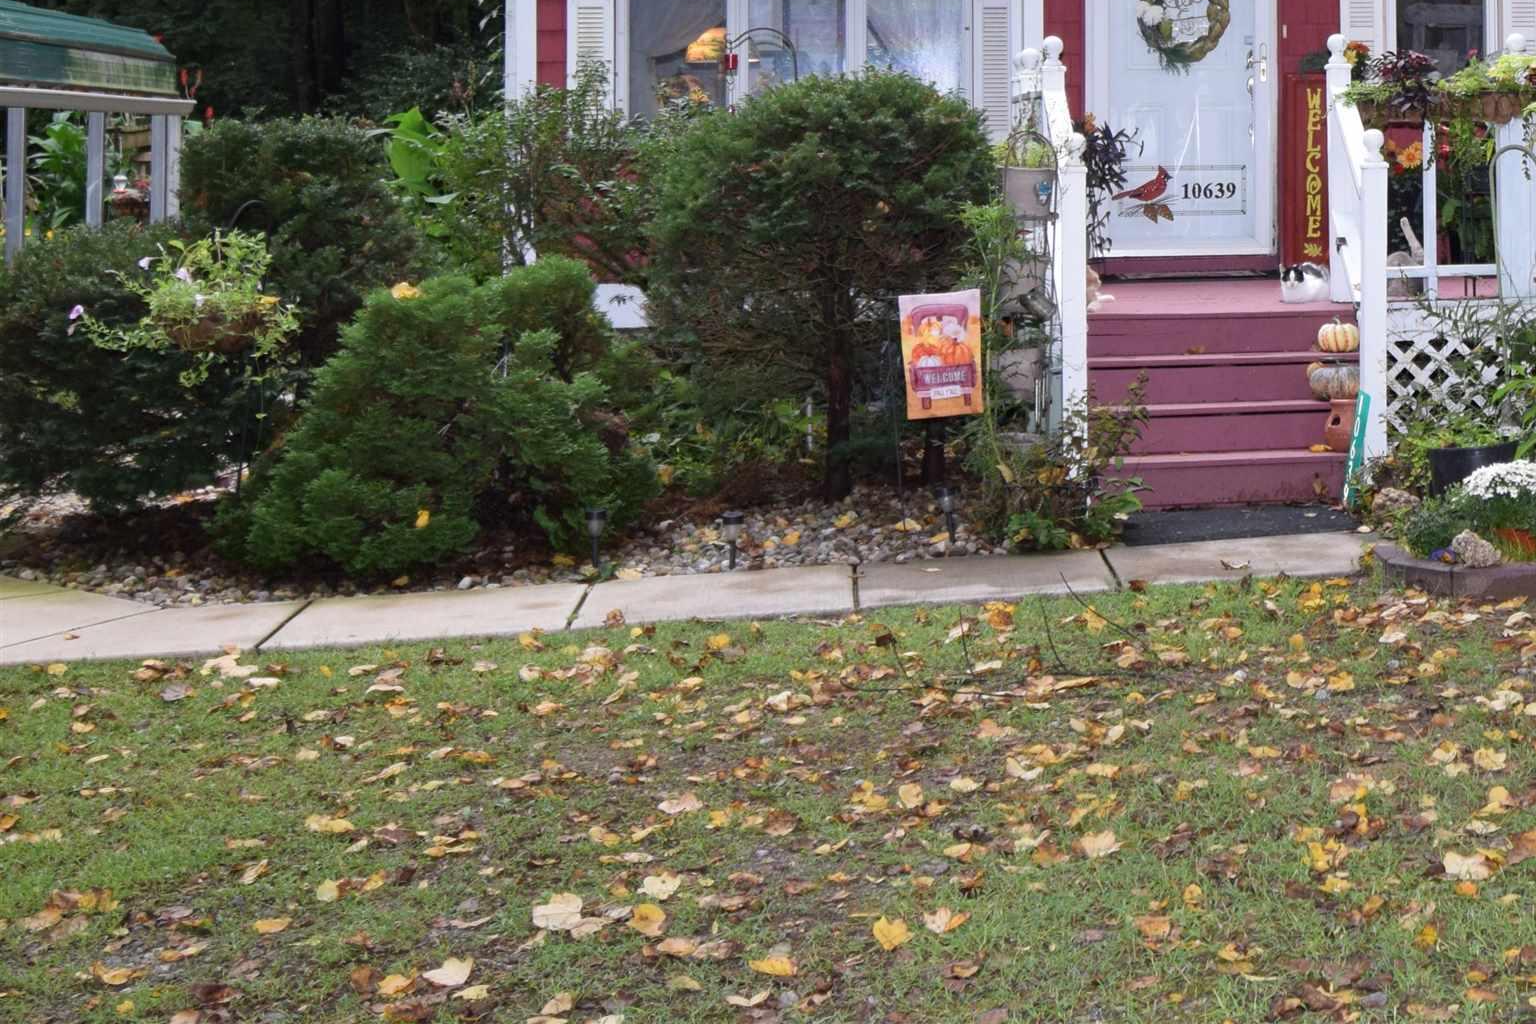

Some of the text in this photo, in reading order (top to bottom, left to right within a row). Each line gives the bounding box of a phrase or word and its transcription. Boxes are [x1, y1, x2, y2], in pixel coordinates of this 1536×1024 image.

[1305, 88, 1322, 238] WELCOME
[1181, 182, 1237, 200] 10639
[923, 371, 967, 385] WELCOME
